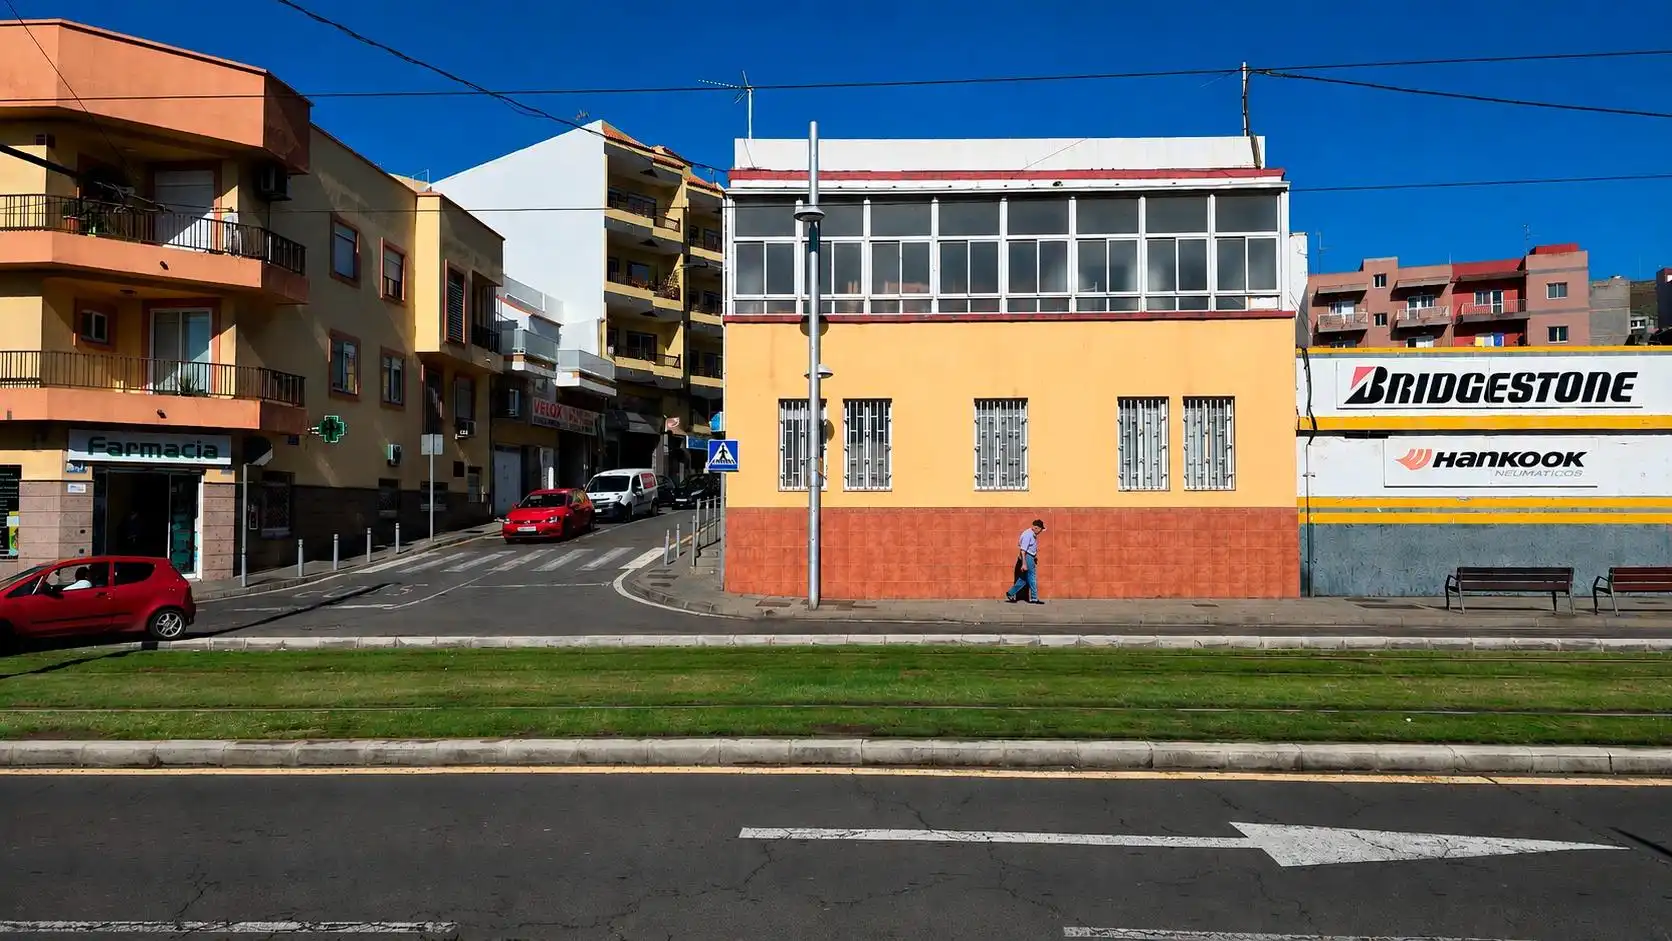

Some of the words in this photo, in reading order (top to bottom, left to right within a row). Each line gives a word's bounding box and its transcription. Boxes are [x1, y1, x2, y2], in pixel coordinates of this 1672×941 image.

[1343, 366, 1638, 404] BRIDGESTONE
[533, 399, 564, 419] VELOX
[88, 436, 218, 459] Farmacia
